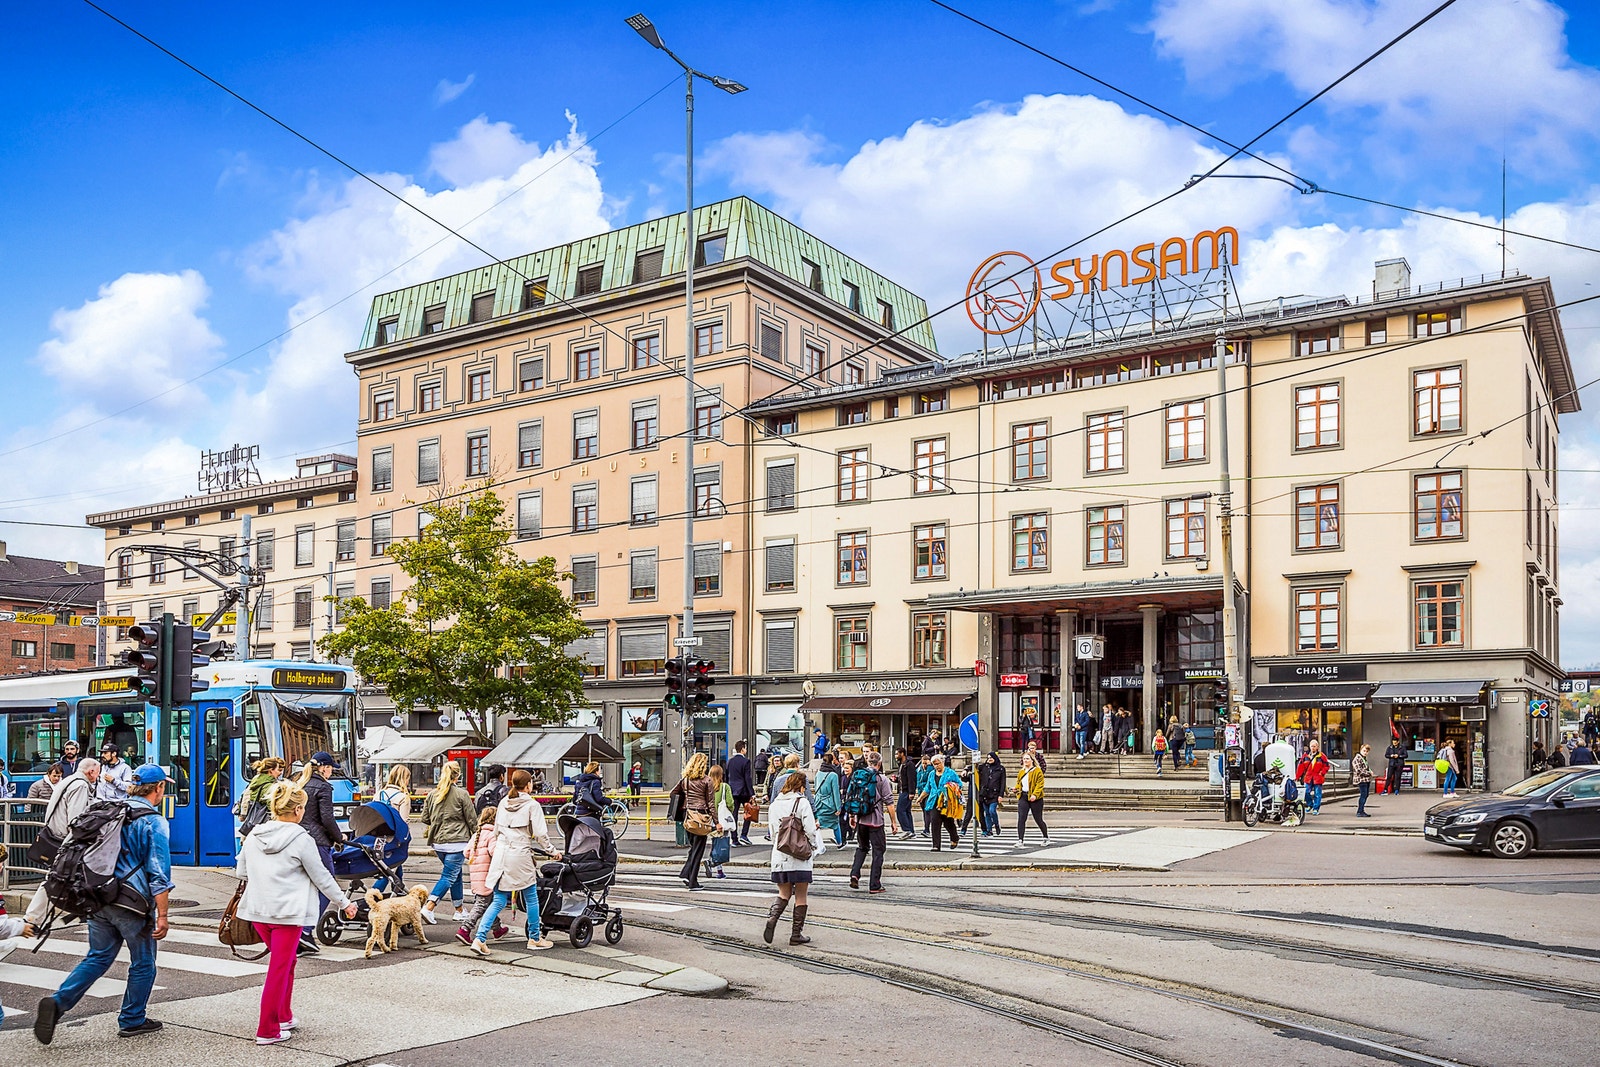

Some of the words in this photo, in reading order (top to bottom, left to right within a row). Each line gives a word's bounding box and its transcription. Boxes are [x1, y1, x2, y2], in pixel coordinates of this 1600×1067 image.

[1051, 226, 1239, 300] SYNSAM
[19, 615, 46, 624] Skøyen
[317, 673, 334, 685] plass
[856, 682, 868, 691] W.
[870, 681, 880, 691] B.
[881, 680, 926, 691] SAMSON
[1393, 696, 1457, 704] MAJOREN
[693, 710, 718, 719] ordea
